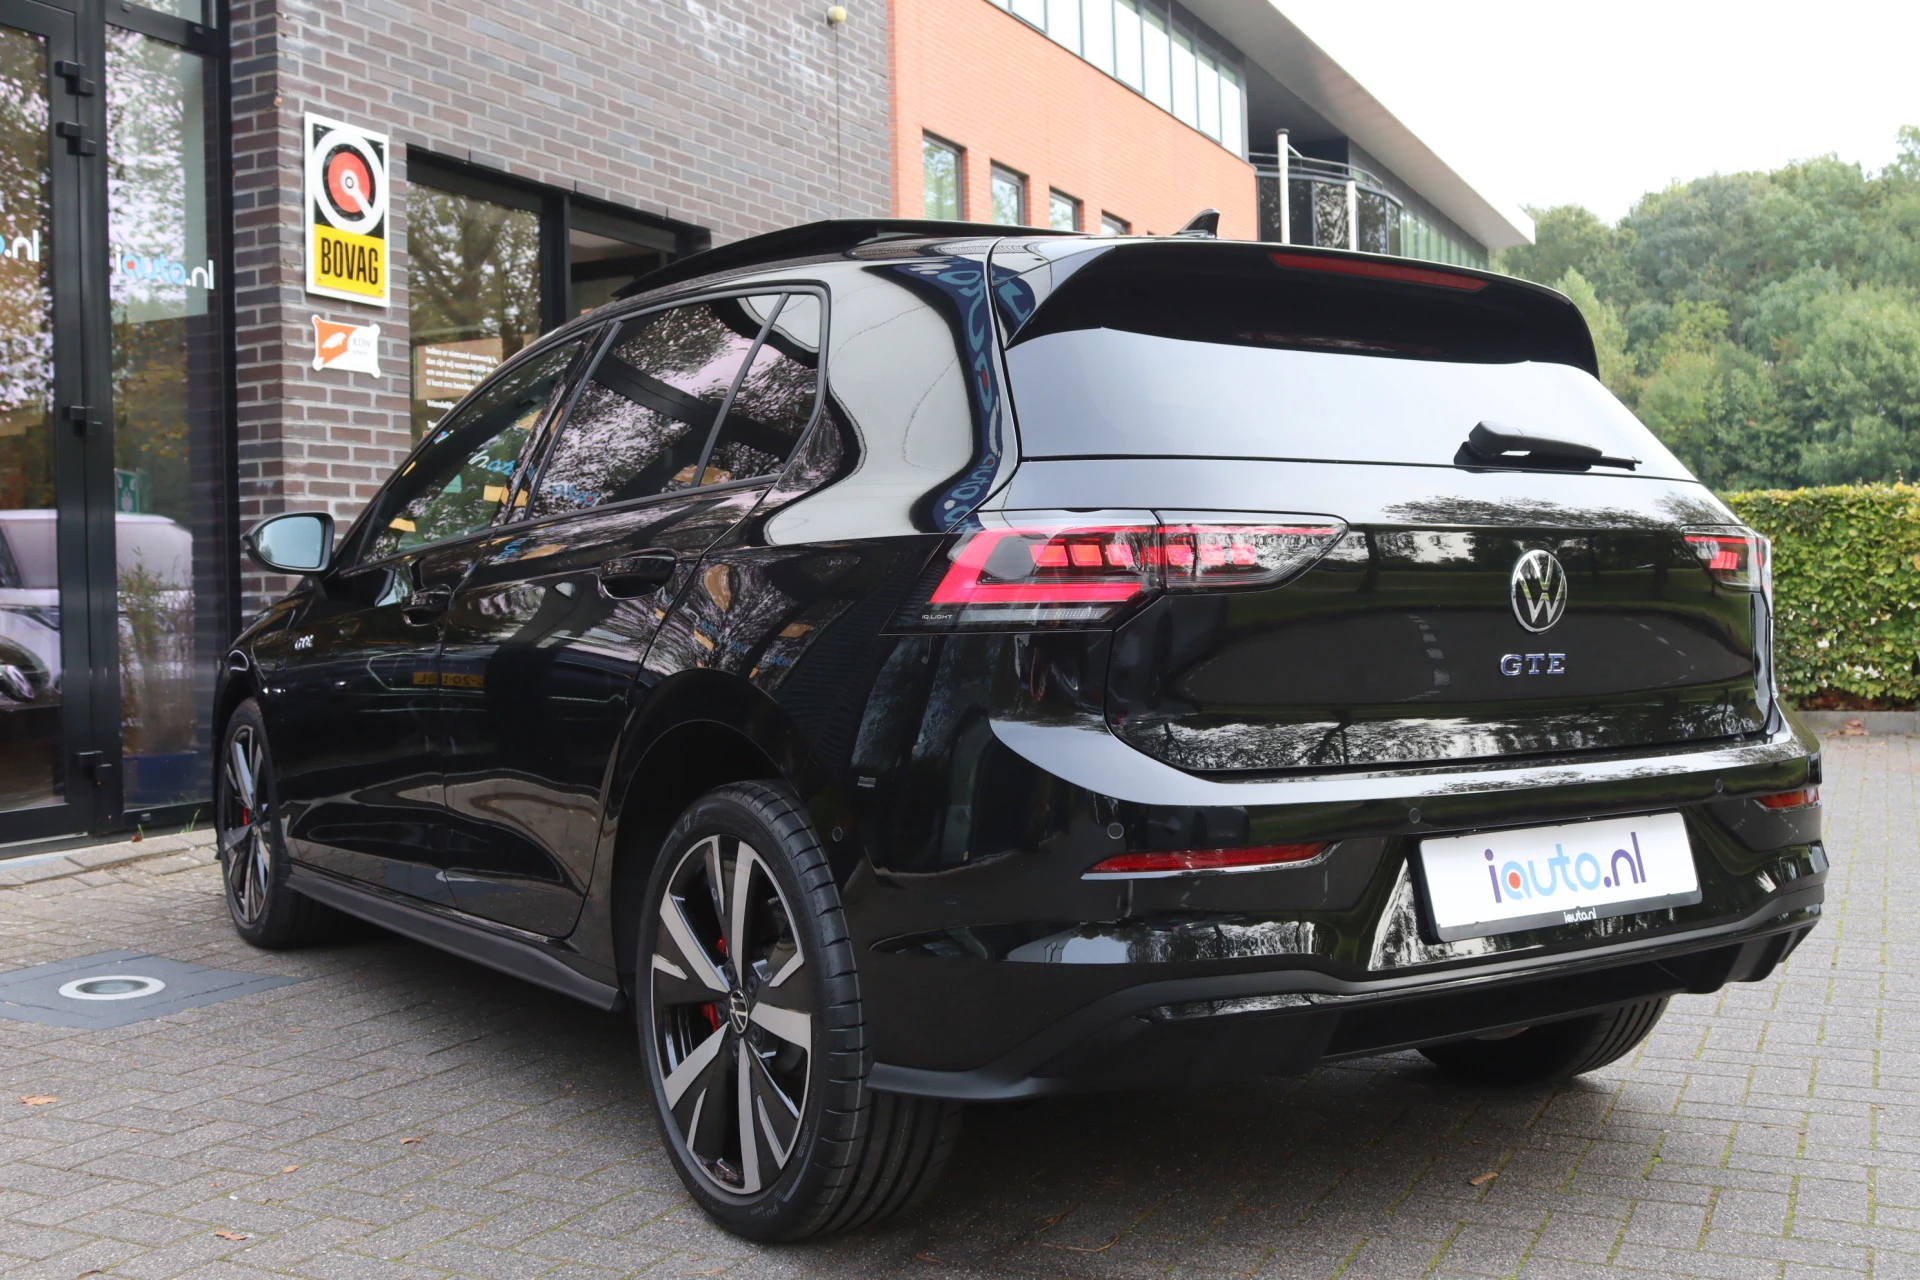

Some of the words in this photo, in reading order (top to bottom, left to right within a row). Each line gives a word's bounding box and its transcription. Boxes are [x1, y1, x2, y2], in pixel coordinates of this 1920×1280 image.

[114, 243, 214, 290] iauto.nl
[321, 237, 378, 285] BOVAG
[1500, 653, 1566, 676] GTE
[1484, 831, 1647, 903] iauto.nl
[1563, 907, 1597, 923] iauto.nl
